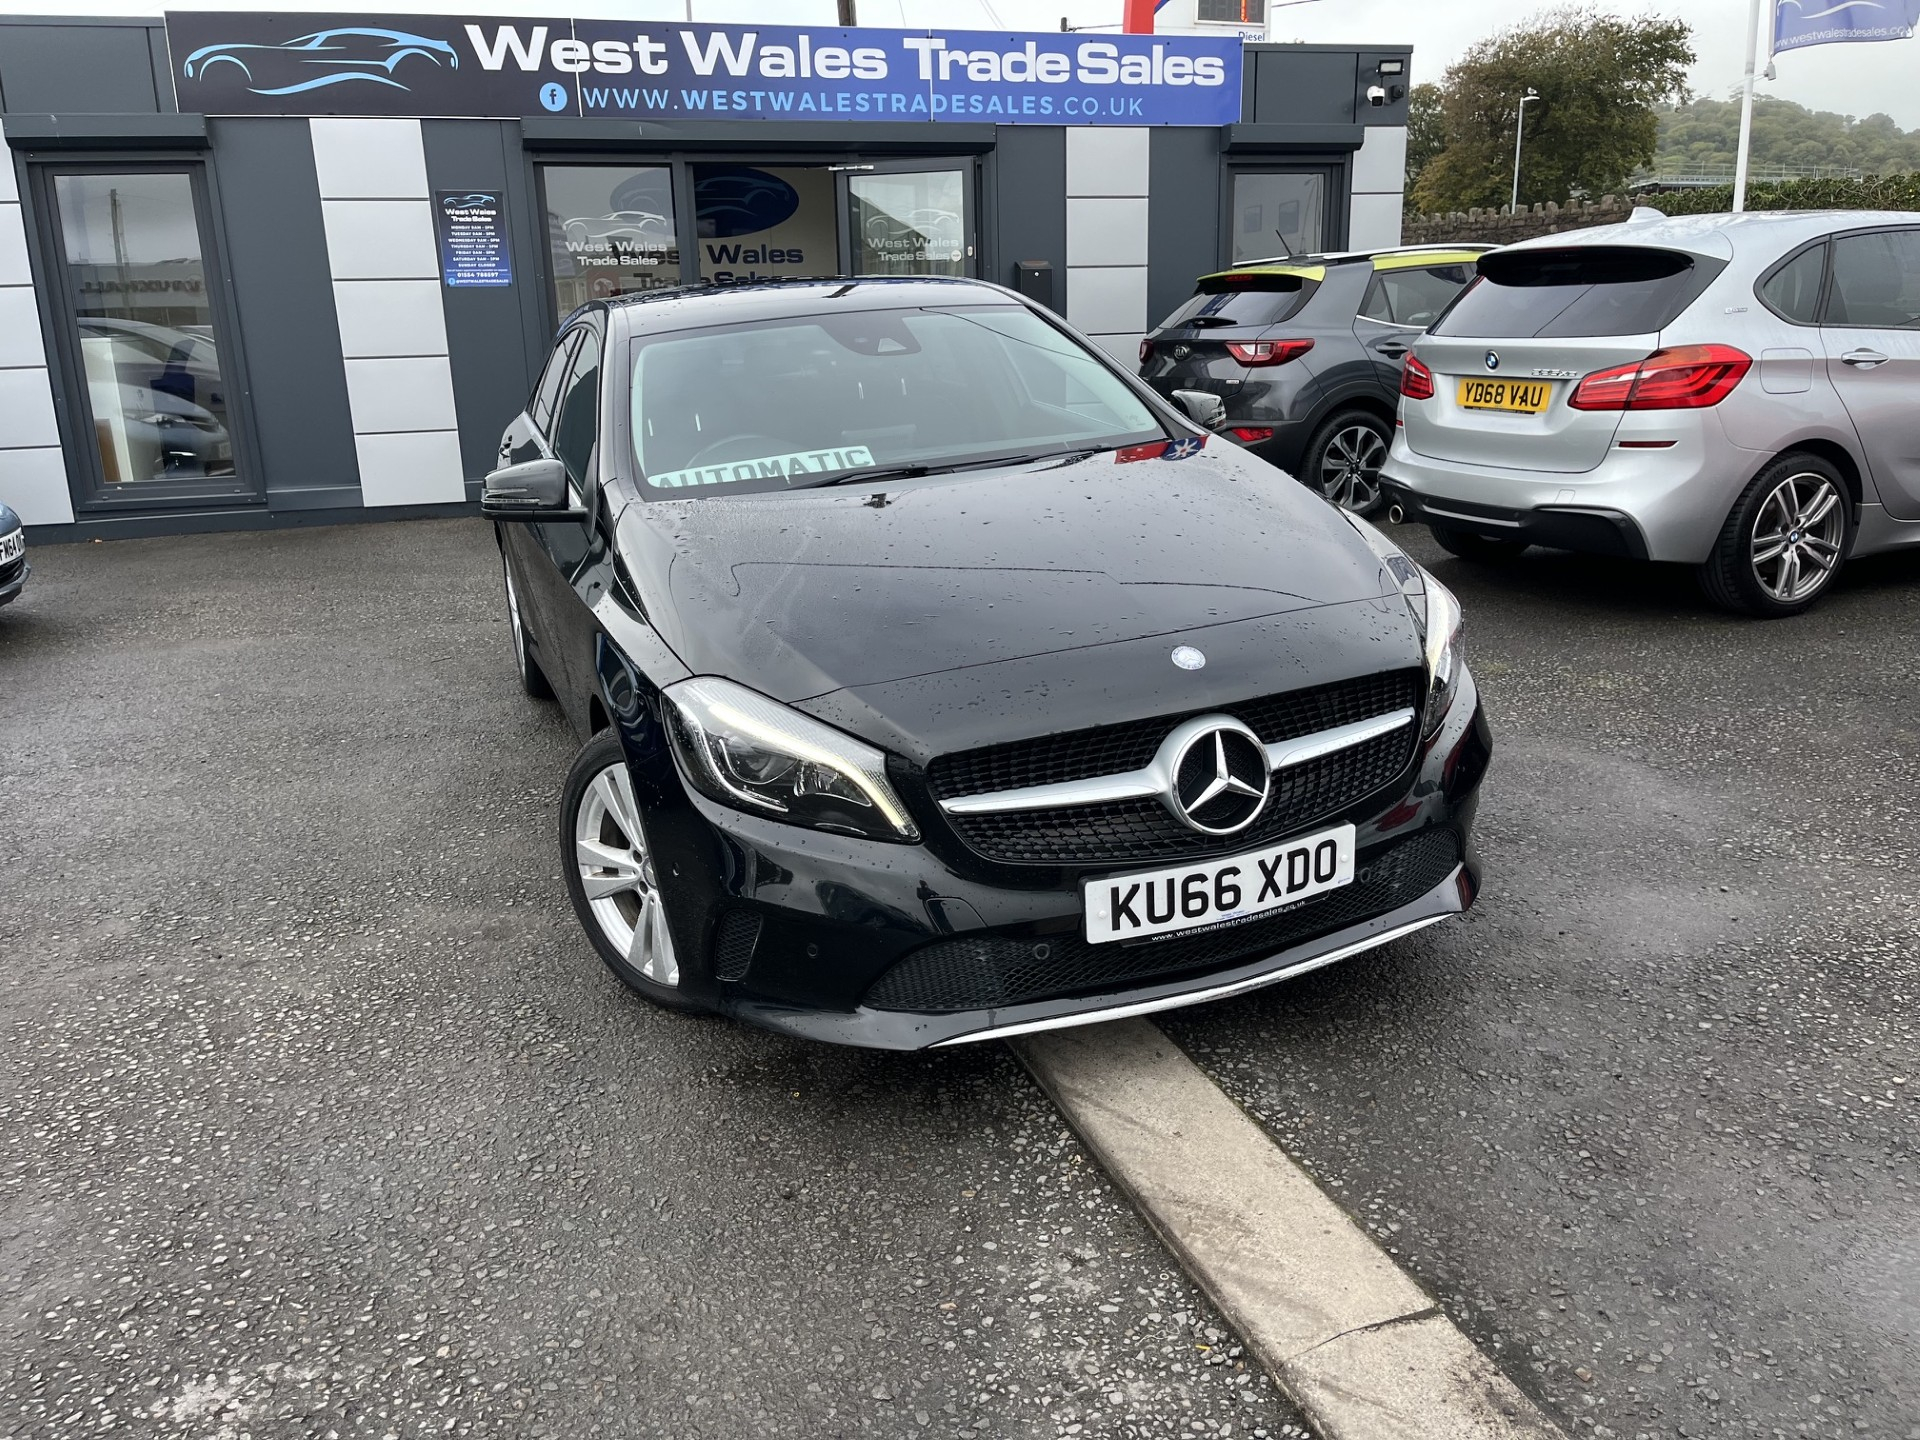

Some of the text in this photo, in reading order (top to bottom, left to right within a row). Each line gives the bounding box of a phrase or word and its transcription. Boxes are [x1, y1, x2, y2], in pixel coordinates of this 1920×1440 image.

[1238, 31, 1265, 42] Diesel
[464, 24, 1225, 87] West Wales Trade Sales
[583, 87, 1143, 116] WWW.WESTWALESTRADESALES.CO.UK
[565, 240, 668, 252] West Wales
[706, 243, 804, 264] Wales
[867, 237, 959, 248] West Wales
[577, 255, 659, 266] Trade Sales
[878, 251, 914, 261] Trade
[915, 250, 951, 260] Sales
[1465, 382, 1544, 407] YD68 VAU
[657, 449, 872, 488] AUTOMATIC
[1110, 838, 1337, 931] KU66 XDO
[1151, 900, 1306, 941] www.westwalestradesales.co.uk
